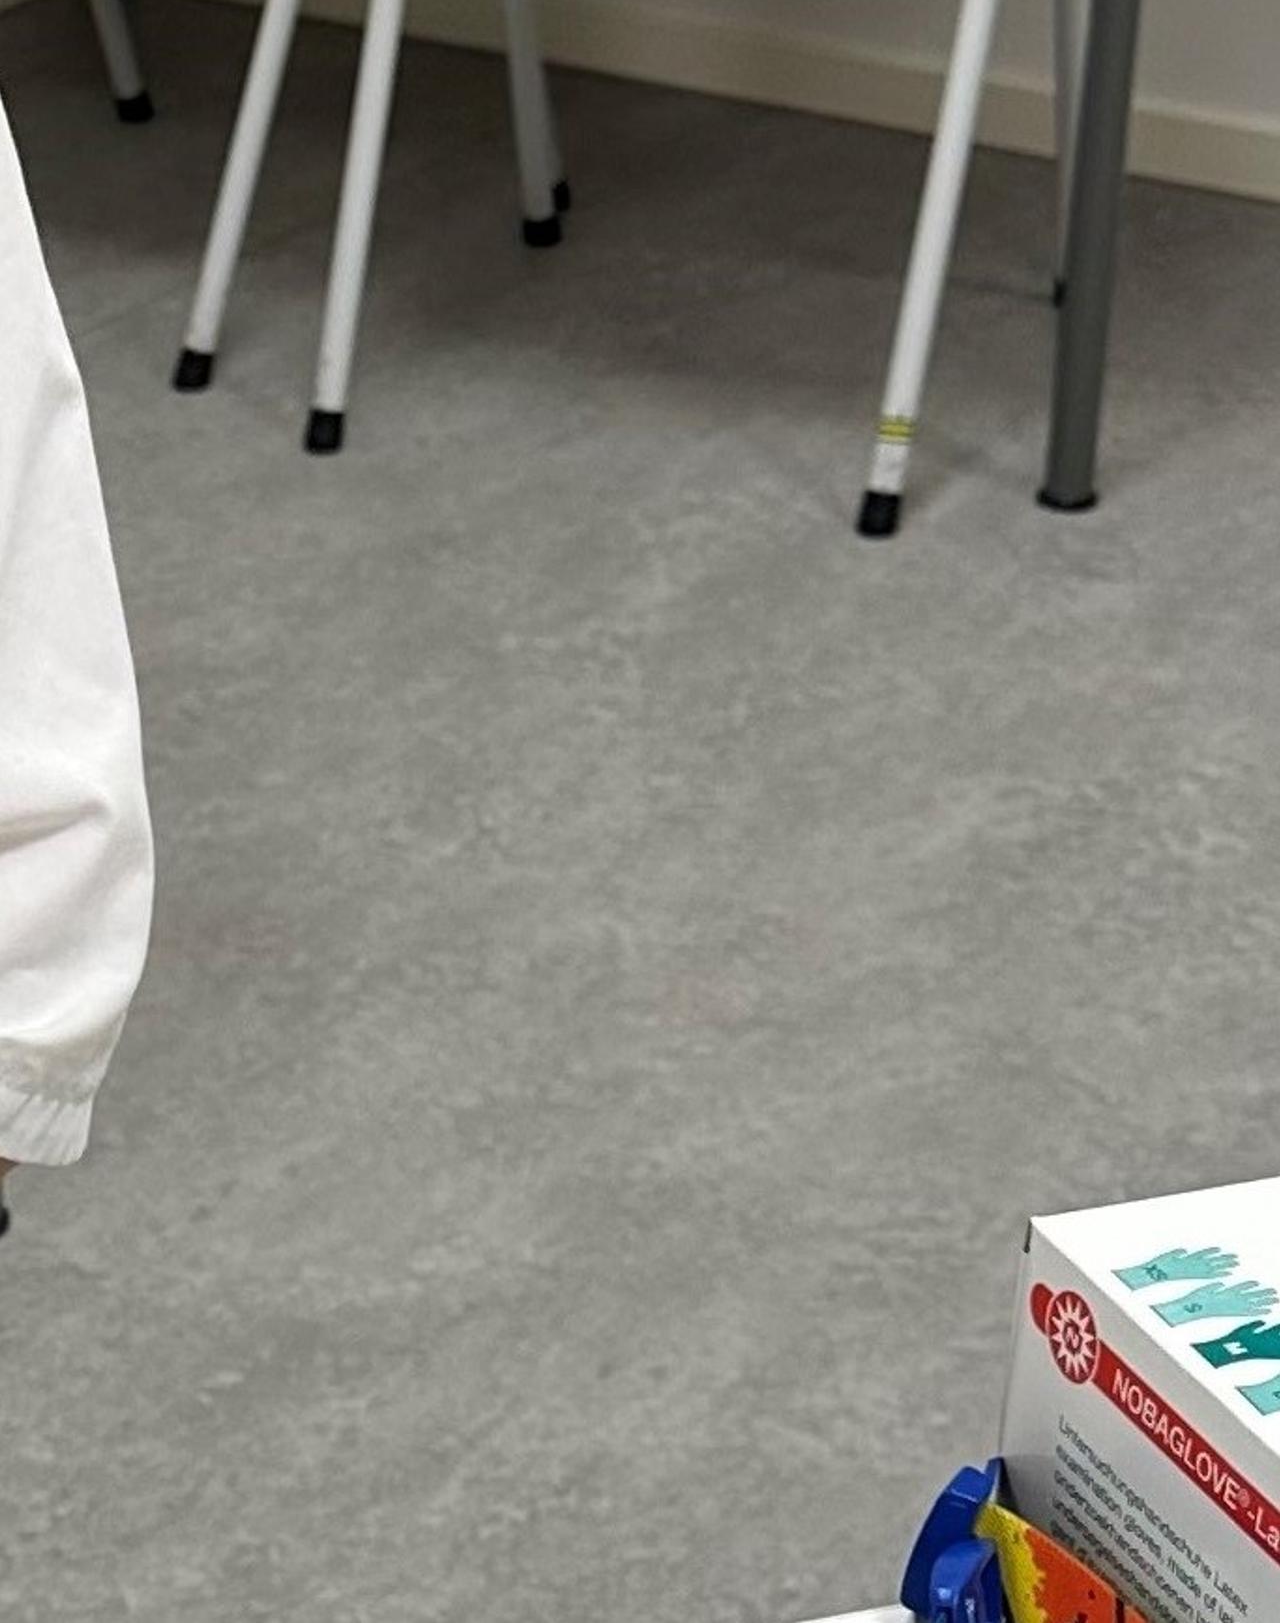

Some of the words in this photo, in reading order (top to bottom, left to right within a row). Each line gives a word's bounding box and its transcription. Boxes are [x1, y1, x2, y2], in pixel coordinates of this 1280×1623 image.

[1144, 1264, 1168, 1280] XS
[1184, 1303, 1203, 1314] S
[1222, 1342, 1248, 1355] M
